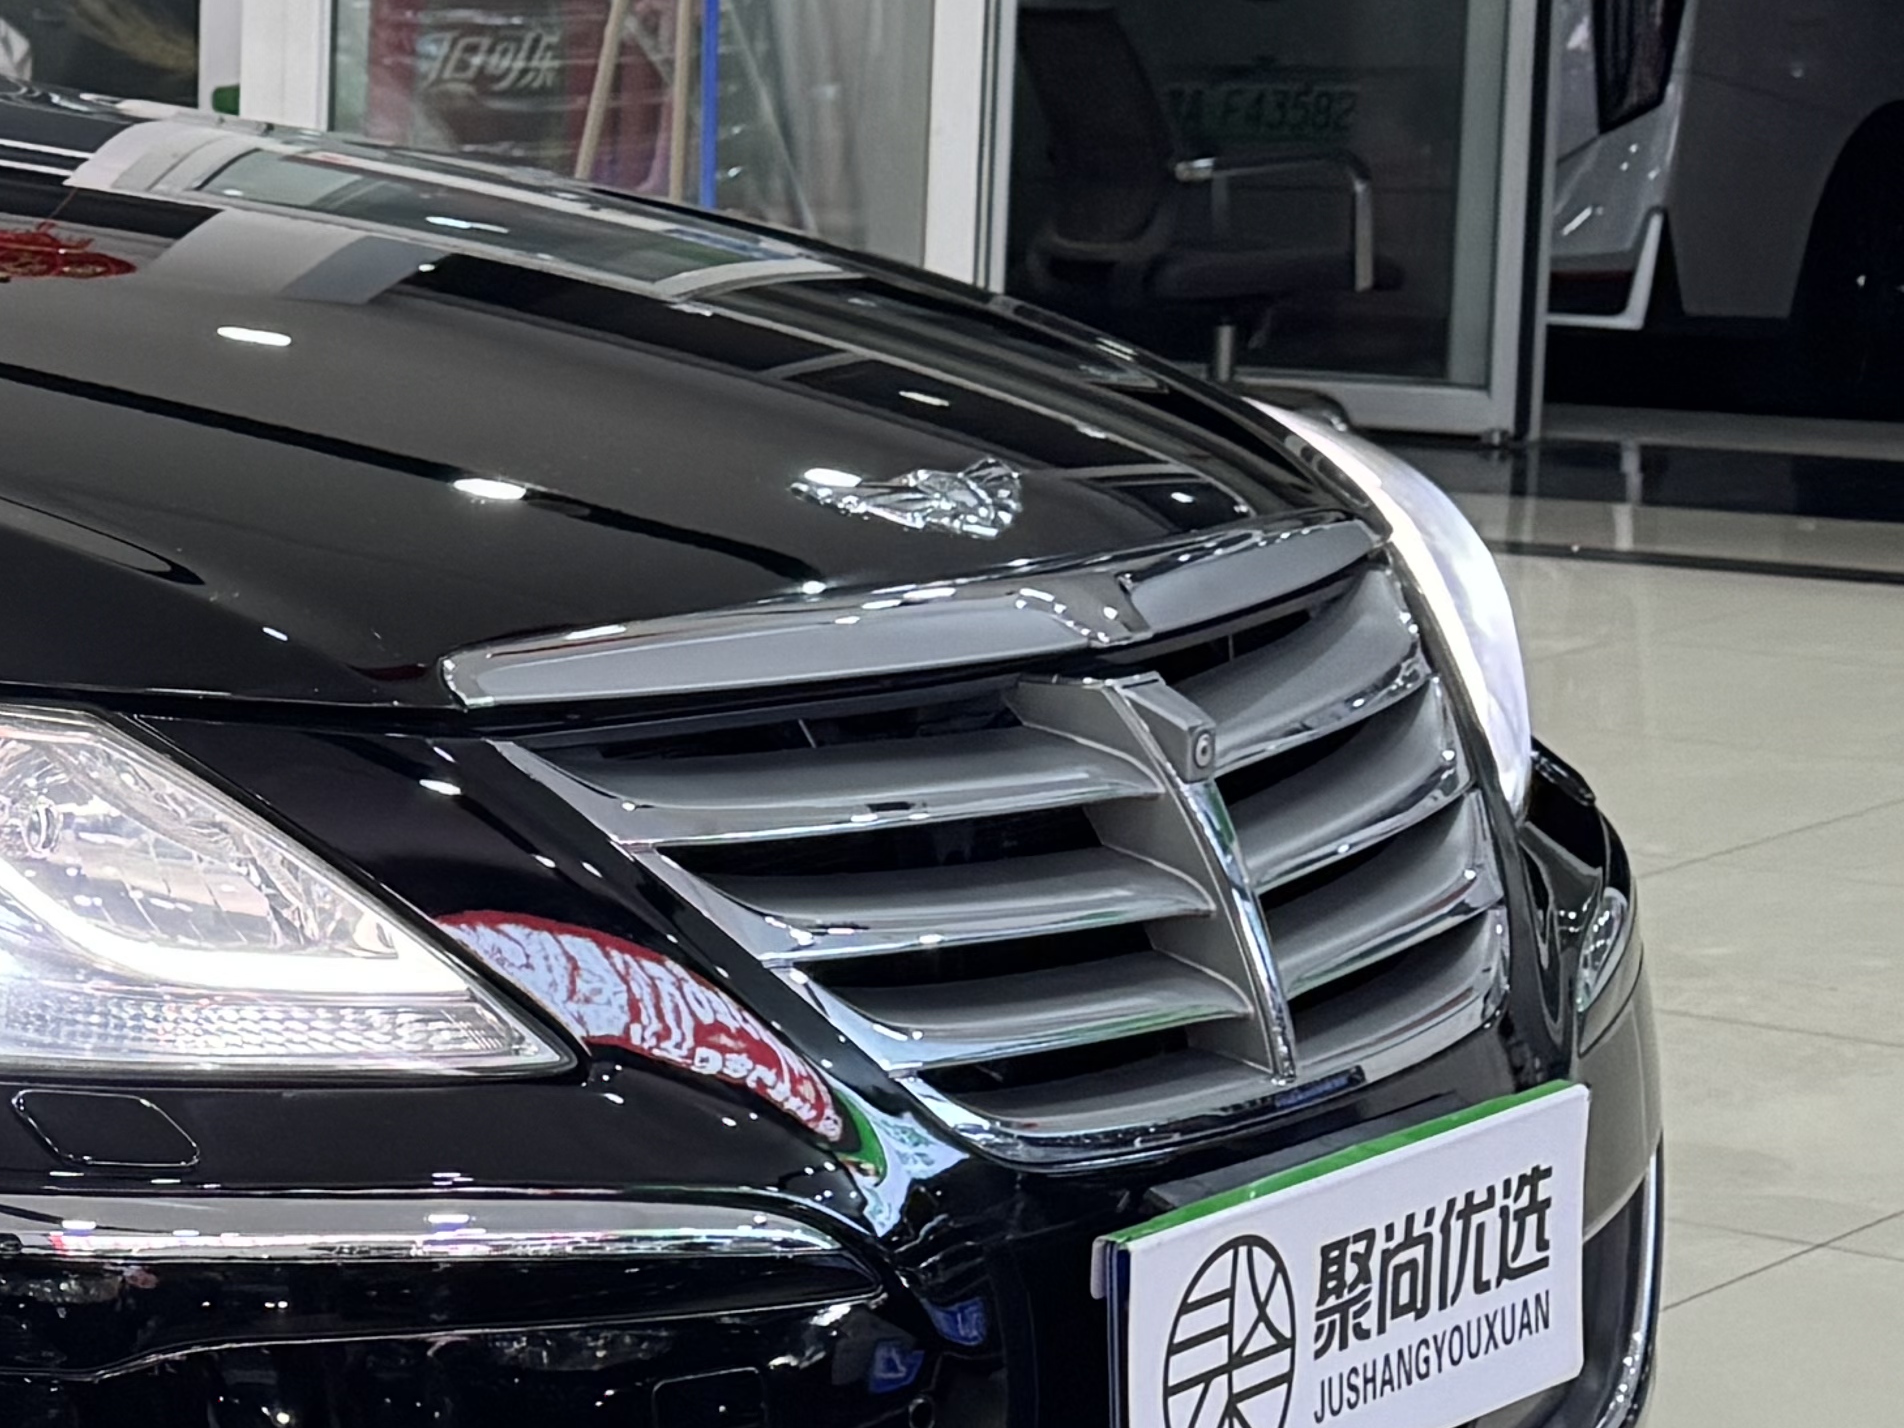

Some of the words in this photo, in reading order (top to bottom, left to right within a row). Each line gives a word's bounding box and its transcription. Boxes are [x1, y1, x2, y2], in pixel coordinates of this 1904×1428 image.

[1313, 1164, 1553, 1361] 聚尚优选
[1313, 1289, 1551, 1424] JUSHANGYOUXUAN
